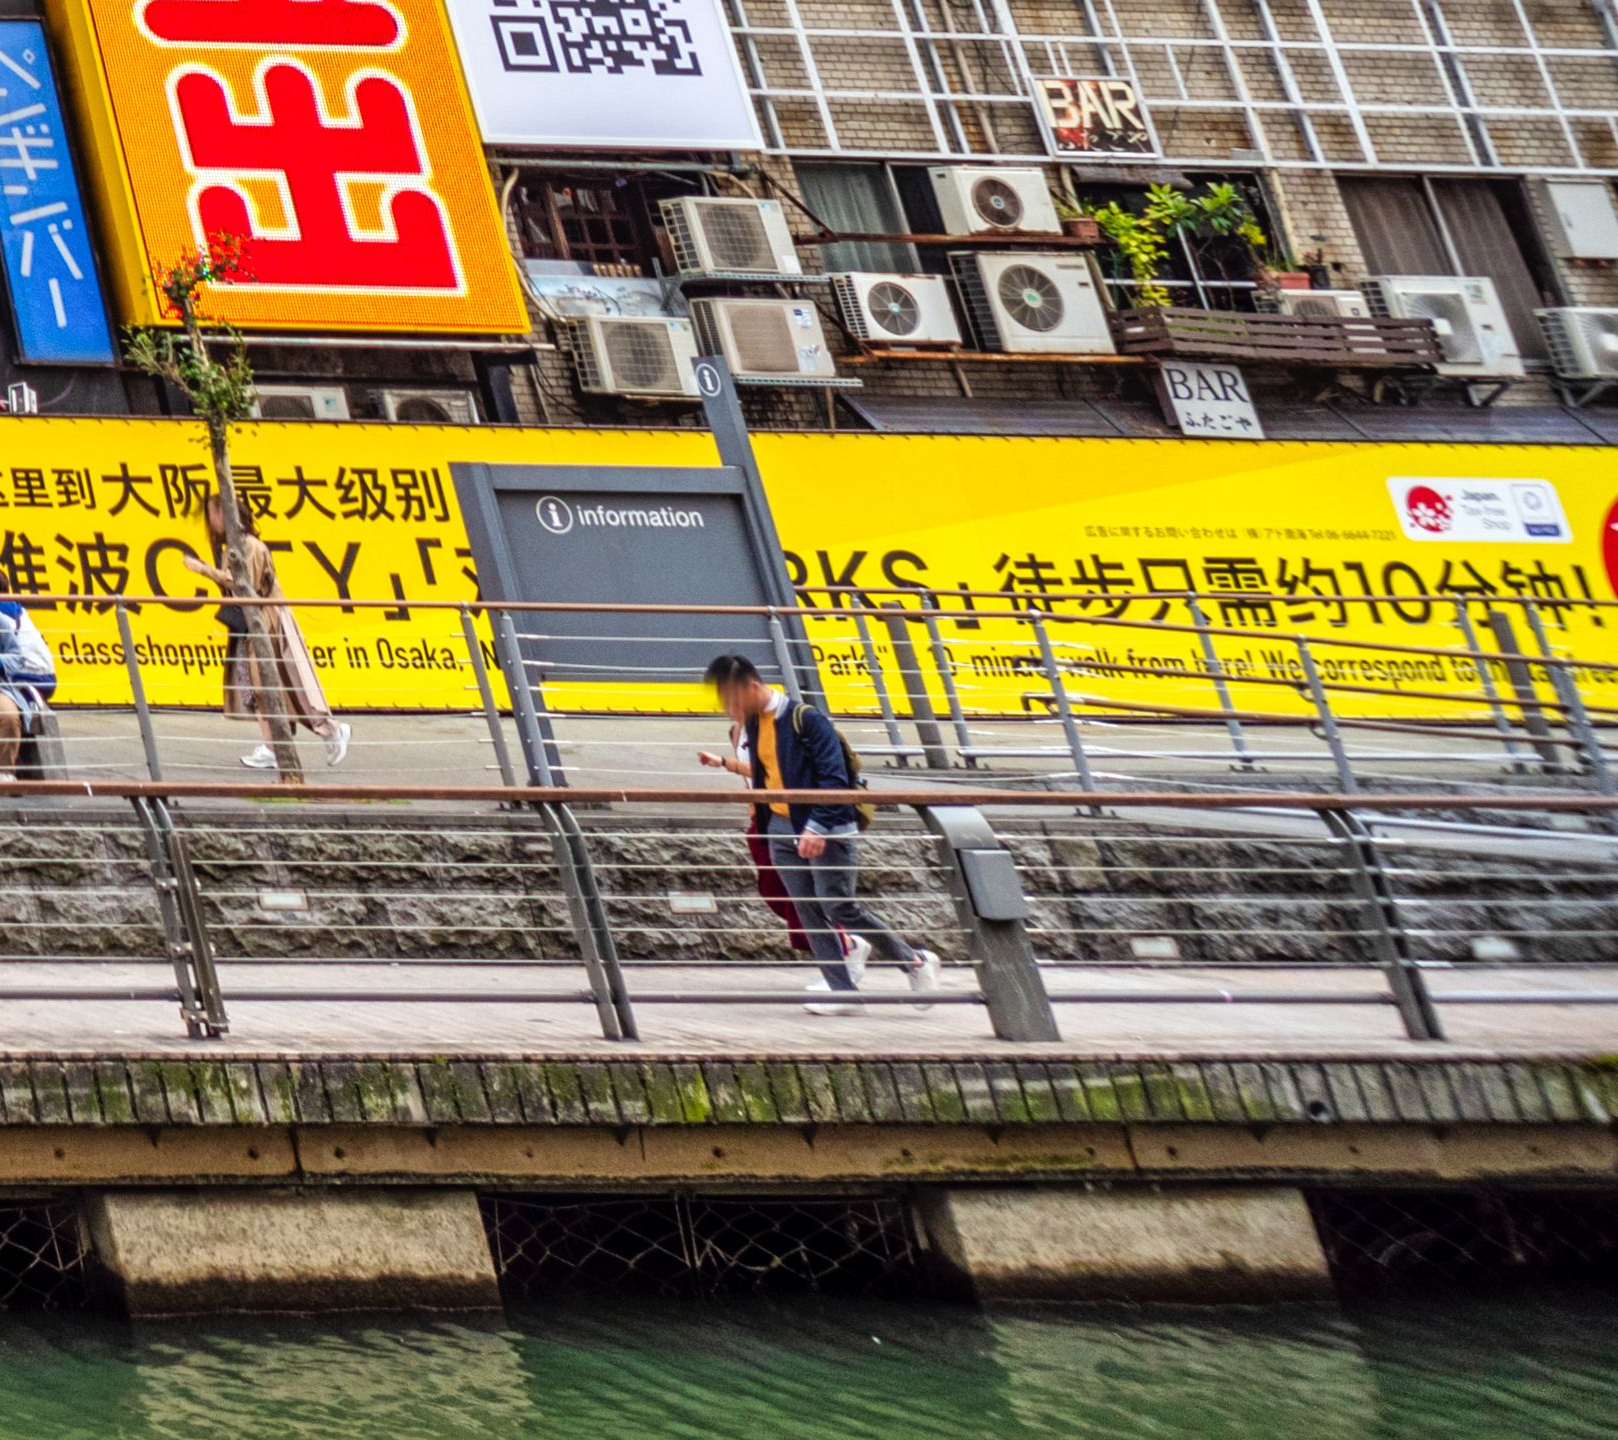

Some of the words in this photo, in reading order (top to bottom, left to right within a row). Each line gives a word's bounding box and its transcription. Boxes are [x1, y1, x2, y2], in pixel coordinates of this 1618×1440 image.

[1036, 80, 1146, 130] BAR
[1164, 369, 1250, 403] BAR
[577, 504, 704, 529] information
[58, 632, 124, 667] class
[380, 637, 465, 673] Osaka,
